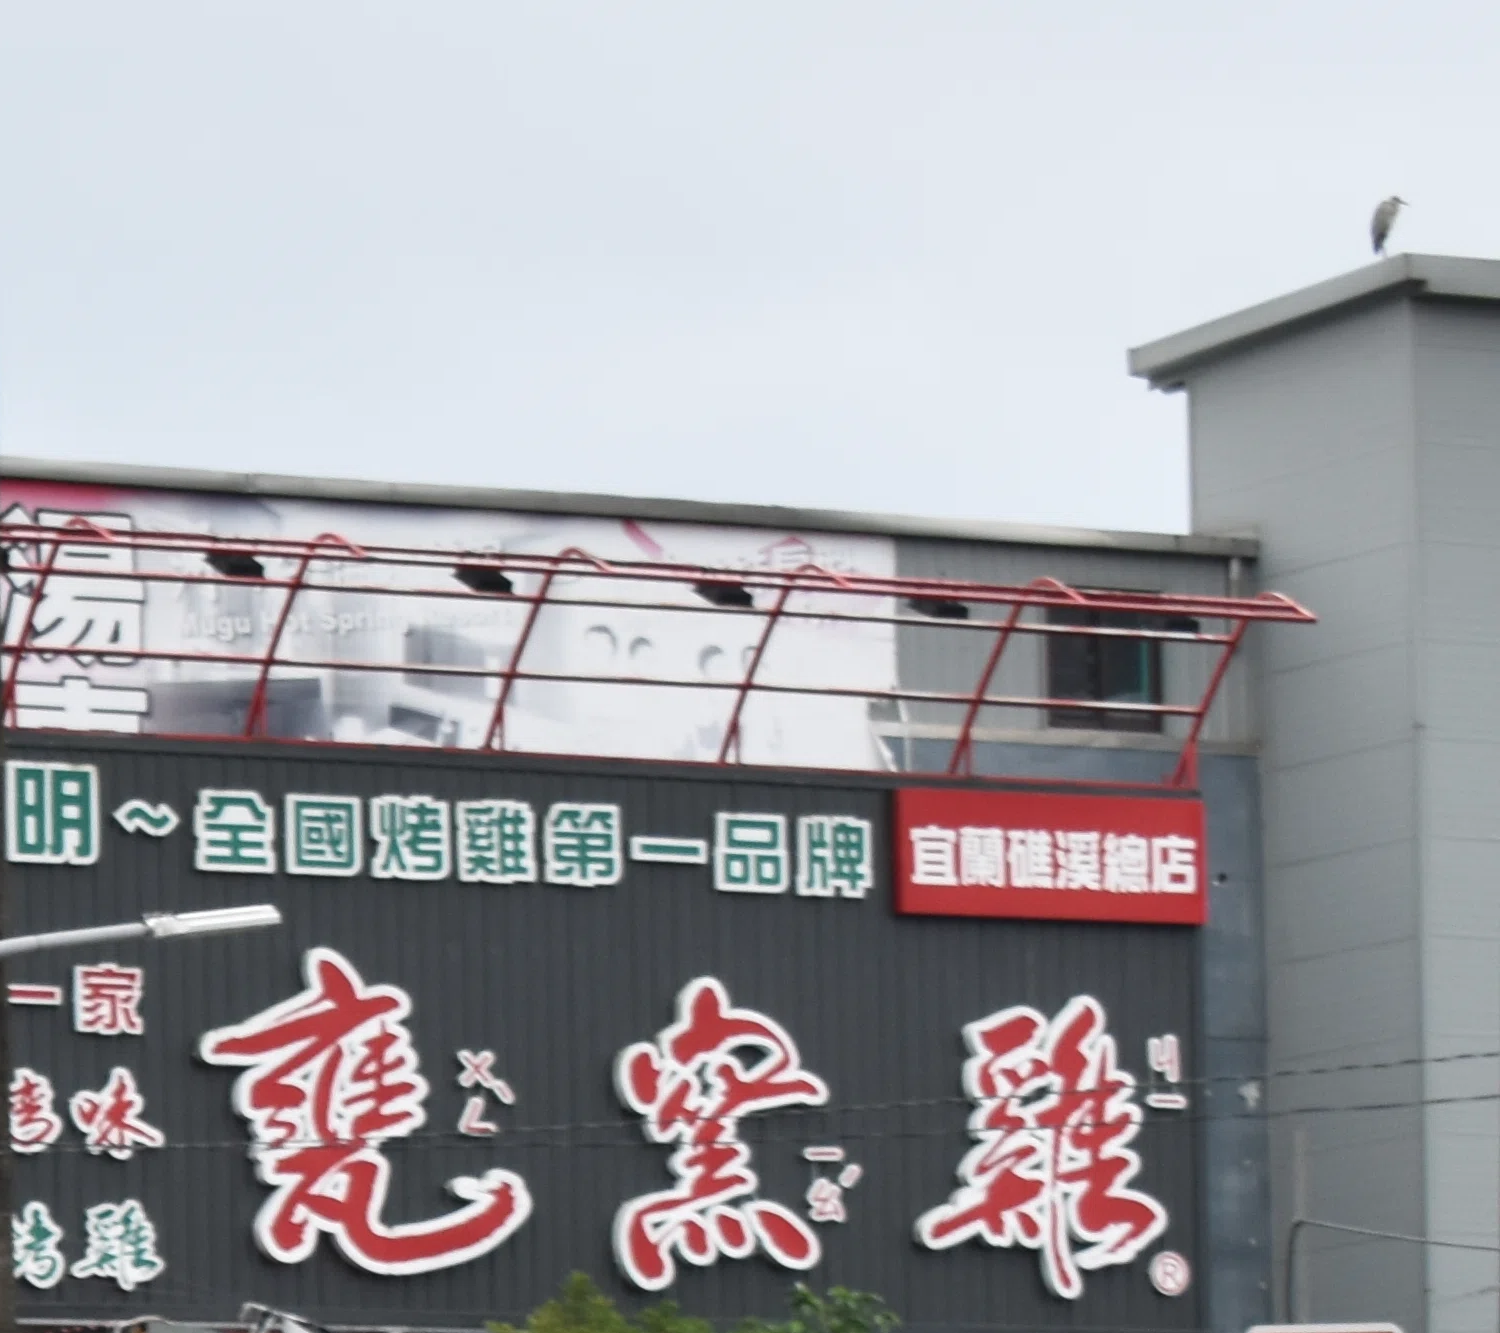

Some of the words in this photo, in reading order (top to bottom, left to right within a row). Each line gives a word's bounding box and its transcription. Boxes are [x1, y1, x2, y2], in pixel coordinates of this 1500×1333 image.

[909, 825, 1198, 895] 宜蘭礁溪總店
